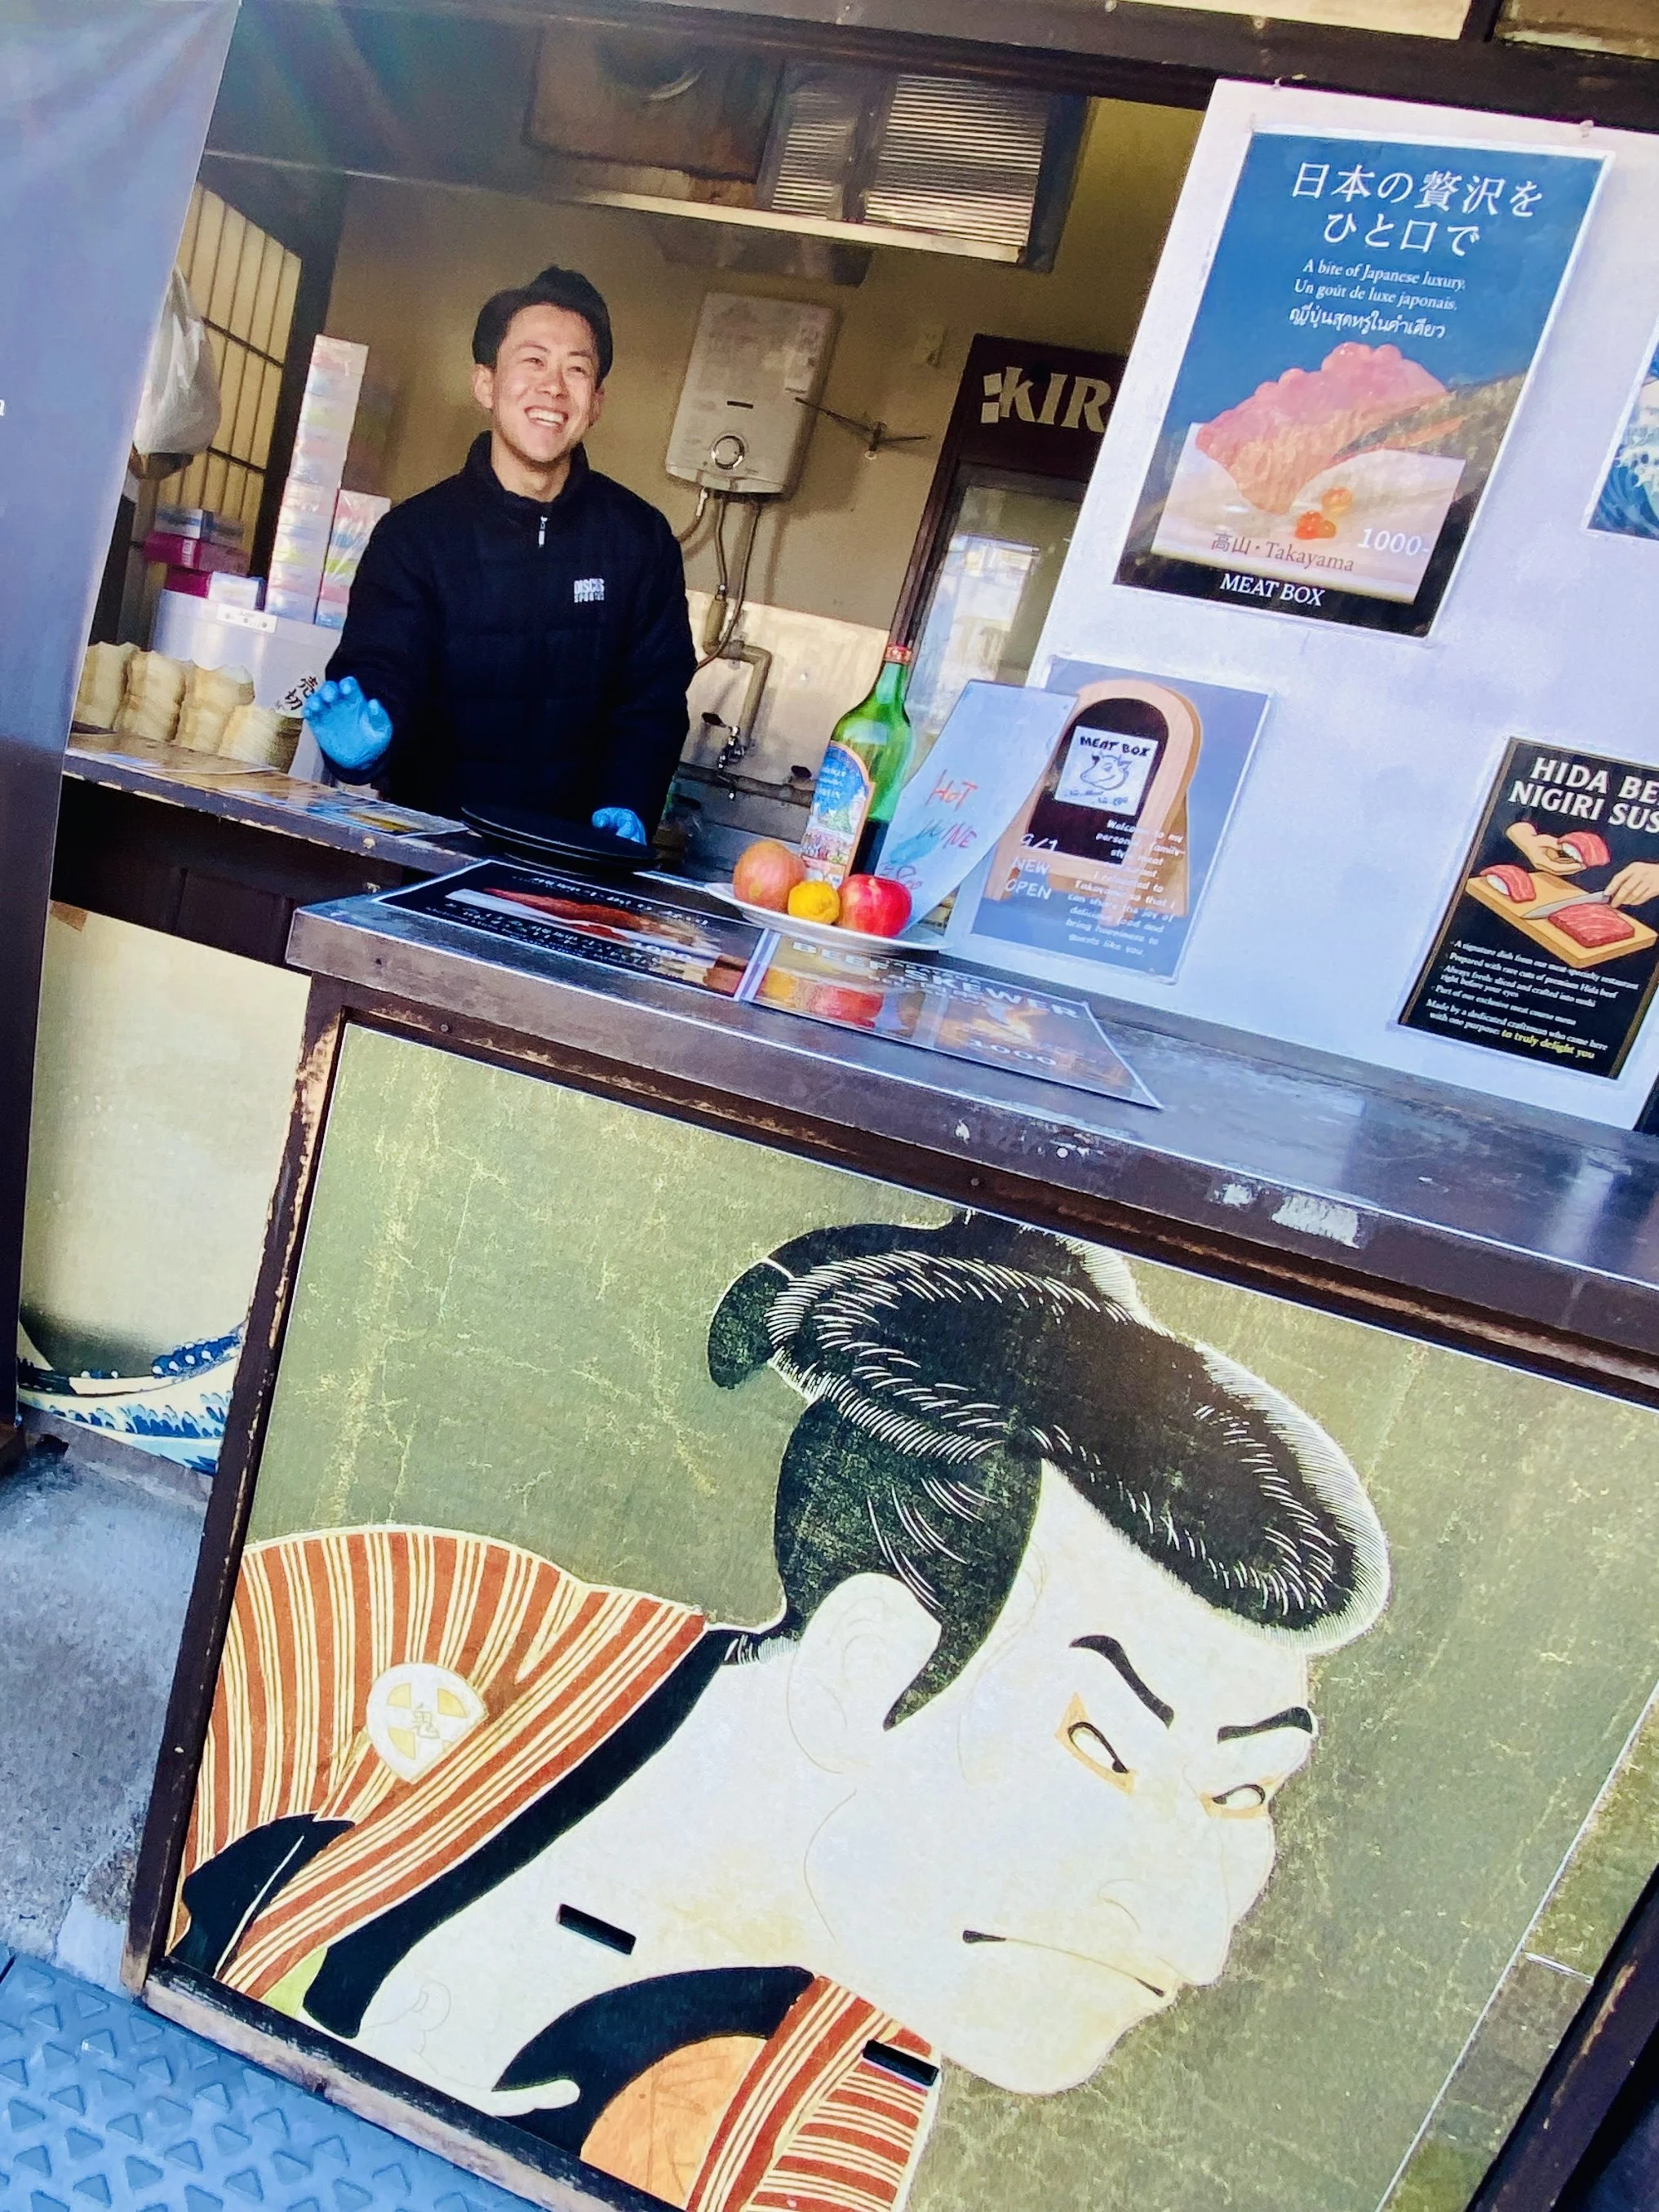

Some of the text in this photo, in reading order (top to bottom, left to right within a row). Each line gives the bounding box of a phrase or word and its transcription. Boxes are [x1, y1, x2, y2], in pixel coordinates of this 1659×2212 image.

[1292, 162, 1542, 218] 日本の贅沢を
[1324, 213, 1480, 256] ひと口で
[1302, 259, 1314, 273] A
[1318, 259, 1343, 276] bite
[1345, 264, 1364, 278] of
[1360, 264, 1420, 285] Japanese
[1294, 278, 1314, 295] Un
[1349, 286, 1366, 300] de
[1368, 286, 1396, 304] luxe
[1397, 291, 1457, 312] japonais.
[1211, 532, 1355, 572] 高山 Takayama
[1219, 573, 1326, 607] MEAT BOX
[1080, 736, 1151, 756] MEAT BOX
[1530, 757, 1609, 794] HIDA
[1508, 780, 1659, 834] NIGIRI SUS
[1107, 818, 1149, 836] Welco
[1013, 857, 1051, 875] NEW
[1005, 878, 1053, 900] OPEN
[1449, 951, 1484, 966] Prepared
[1580, 983, 1599, 994] Hida
[1599, 988, 1619, 999] beef
[903, 968, 1081, 1020] SKEWER
[1426, 998, 1449, 1011] Made
[1502, 1030, 1513, 1038] to
[1514, 1032, 1539, 1048] truly
[1540, 1038, 1576, 1054] delight
[1575, 1049, 1595, 1059] you
